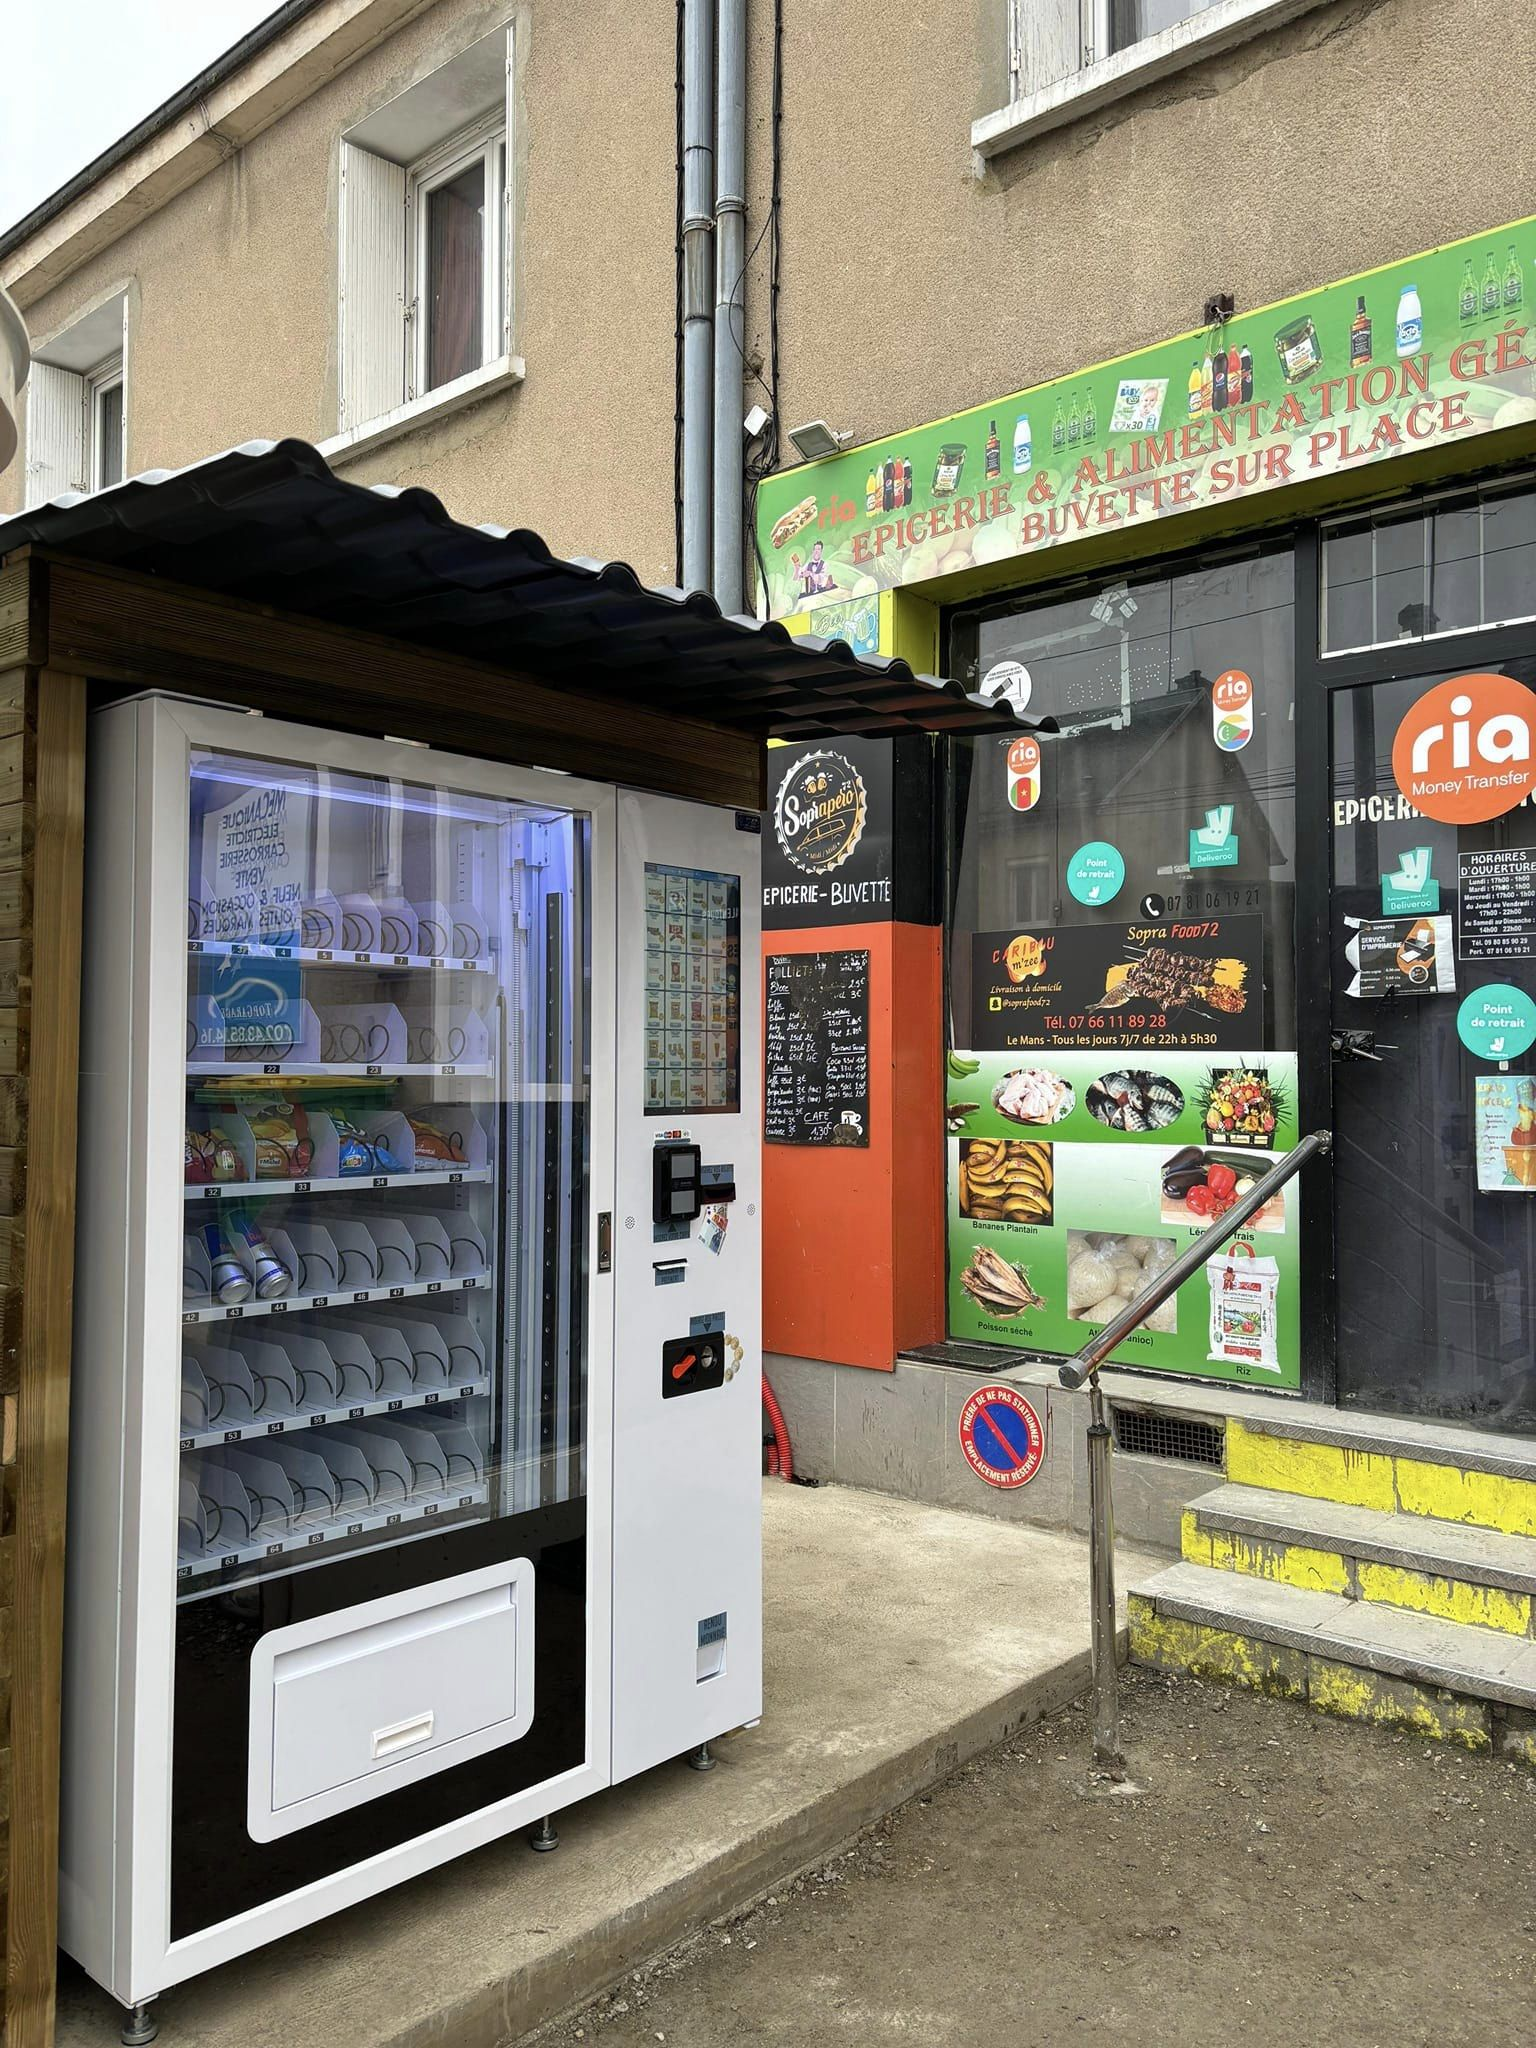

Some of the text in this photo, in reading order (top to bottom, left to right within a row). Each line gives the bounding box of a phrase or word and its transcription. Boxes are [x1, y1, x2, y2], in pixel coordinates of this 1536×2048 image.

[851, 483, 1016, 566] EPICERIE
[1027, 470, 1056, 505] &
[1071, 352, 1433, 494] ALIMENTATION
[1021, 391, 1476, 546] BUVETTE SUR PLACE
[1217, 676, 1248, 699] ria
[1412, 695, 1530, 774] ria
[1011, 742, 1037, 763] ria
[1412, 771, 1530, 797] Money Transfer
[1086, 858, 1108, 868] Point
[1197, 853, 1233, 863] Deliveroo
[1471, 852, 1527, 865] HORAIRES
[1077, 869, 1116, 879] de retrait
[1461, 862, 1536, 876] D'OUVERTURE
[1469, 878, 1486, 886] Lundi
[1491, 876, 1510, 884] 17h00
[1168, 896, 1181, 912] 07
[1206, 893, 1220, 908] 06
[1227, 891, 1240, 907] 19
[1246, 889, 1259, 906] 21
[1520, 890, 1536, 898] 1h00
[1391, 899, 1432, 911] Deliveroo
[1127, 926, 1167, 946] Sopra
[1361, 936, 1386, 944] SERVICE
[1012, 957, 1039, 972] m'zee
[989, 981, 1063, 995] Livraison à domicile
[1002, 996, 1051, 1012] @soprafood72
[1483, 1004, 1513, 1015] Point
[1044, 1014, 1166, 1029] Tél. 07 66 11 89 28
[1471, 1018, 1526, 1028] de retrait
[1007, 1033, 1217, 1047] Le Mans Tous les jours 7j/7 de 22h à 5h30
[972, 1221, 1038, 1236] Bananes Plantain
[977, 1321, 1034, 1337] Poisson séché
[1236, 1366, 1252, 1376] Riz
[963, 1391, 1040, 1447] PRIÈRE DE NE PAS STATIONNER
[964, 1440, 1010, 1483] EMPLACEMENT
